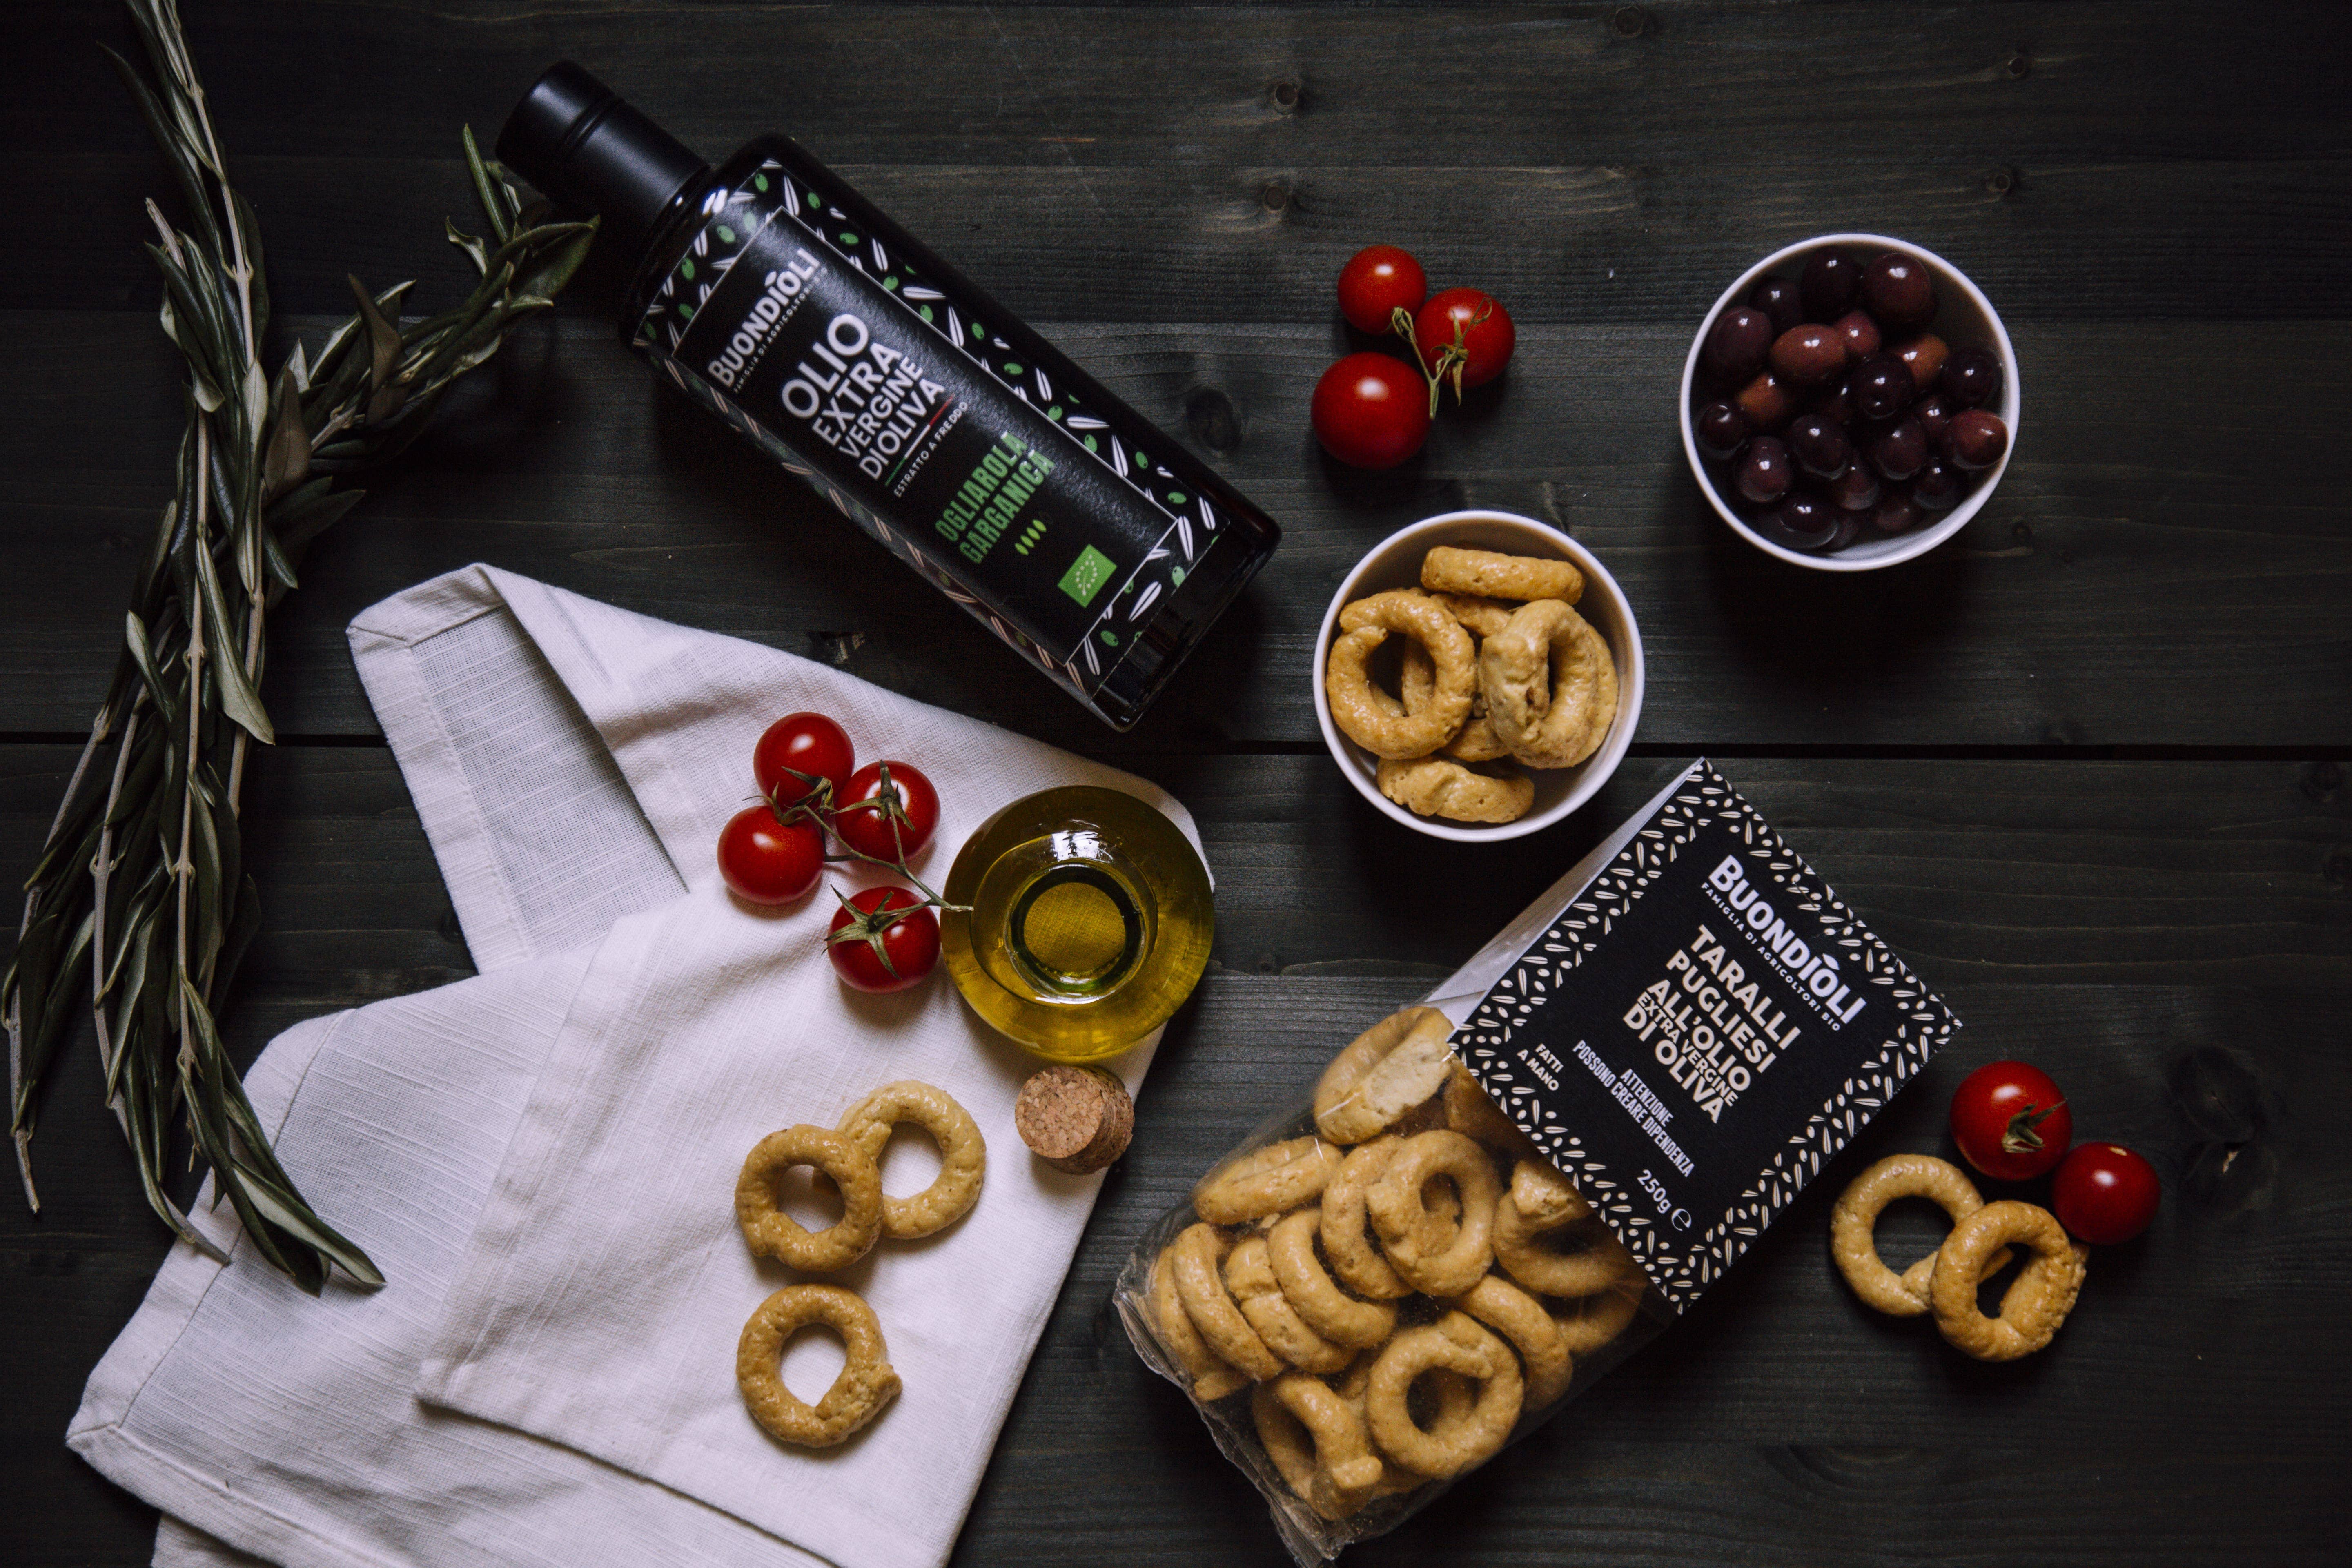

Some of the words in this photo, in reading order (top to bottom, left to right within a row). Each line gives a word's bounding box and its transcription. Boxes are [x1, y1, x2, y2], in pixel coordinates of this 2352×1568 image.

[782, 314, 869, 419] OLIO
[812, 343, 902, 447] EXTRA
[838, 356, 924, 458] VERGINE
[894, 450, 929, 498] ESTRATTO
[928, 441, 937, 451] A
[934, 401, 968, 441] FREDDO
[935, 430, 1028, 542] OGLIAROLA
[960, 449, 1055, 563] GARGANICA
[1666, 949, 1777, 1073] PUGLIESI
[1690, 924, 1801, 1050] TARALLI
[1701, 882, 1745, 931] FAMIGLIA
[1745, 931, 1757, 944] DI
[1757, 946, 1821, 1011] AGRICOLTORI
[1821, 1012, 1841, 1031] BIO
[1517, 1049, 1529, 1061] A
[1526, 1058, 1559, 1091] MANO
[1535, 1043, 1564, 1073] FATTI
[1623, 1003, 1657, 1042] DI
[1655, 1039, 1724, 1124] OLIVA
[1637, 991, 1680, 1044] EXTRA
[1681, 1039, 1739, 1107] VERGINE
[1647, 979, 1751, 1091] ALL'OLIO
[1572, 1040, 1617, 1087] POSSONO
[1611, 1082, 1648, 1123] CREARE
[1642, 1117, 1695, 1177] DIPENDENZA
[1620, 1069, 1674, 1127] ATTENZIONE
[1637, 1169, 1672, 1214] 250g
